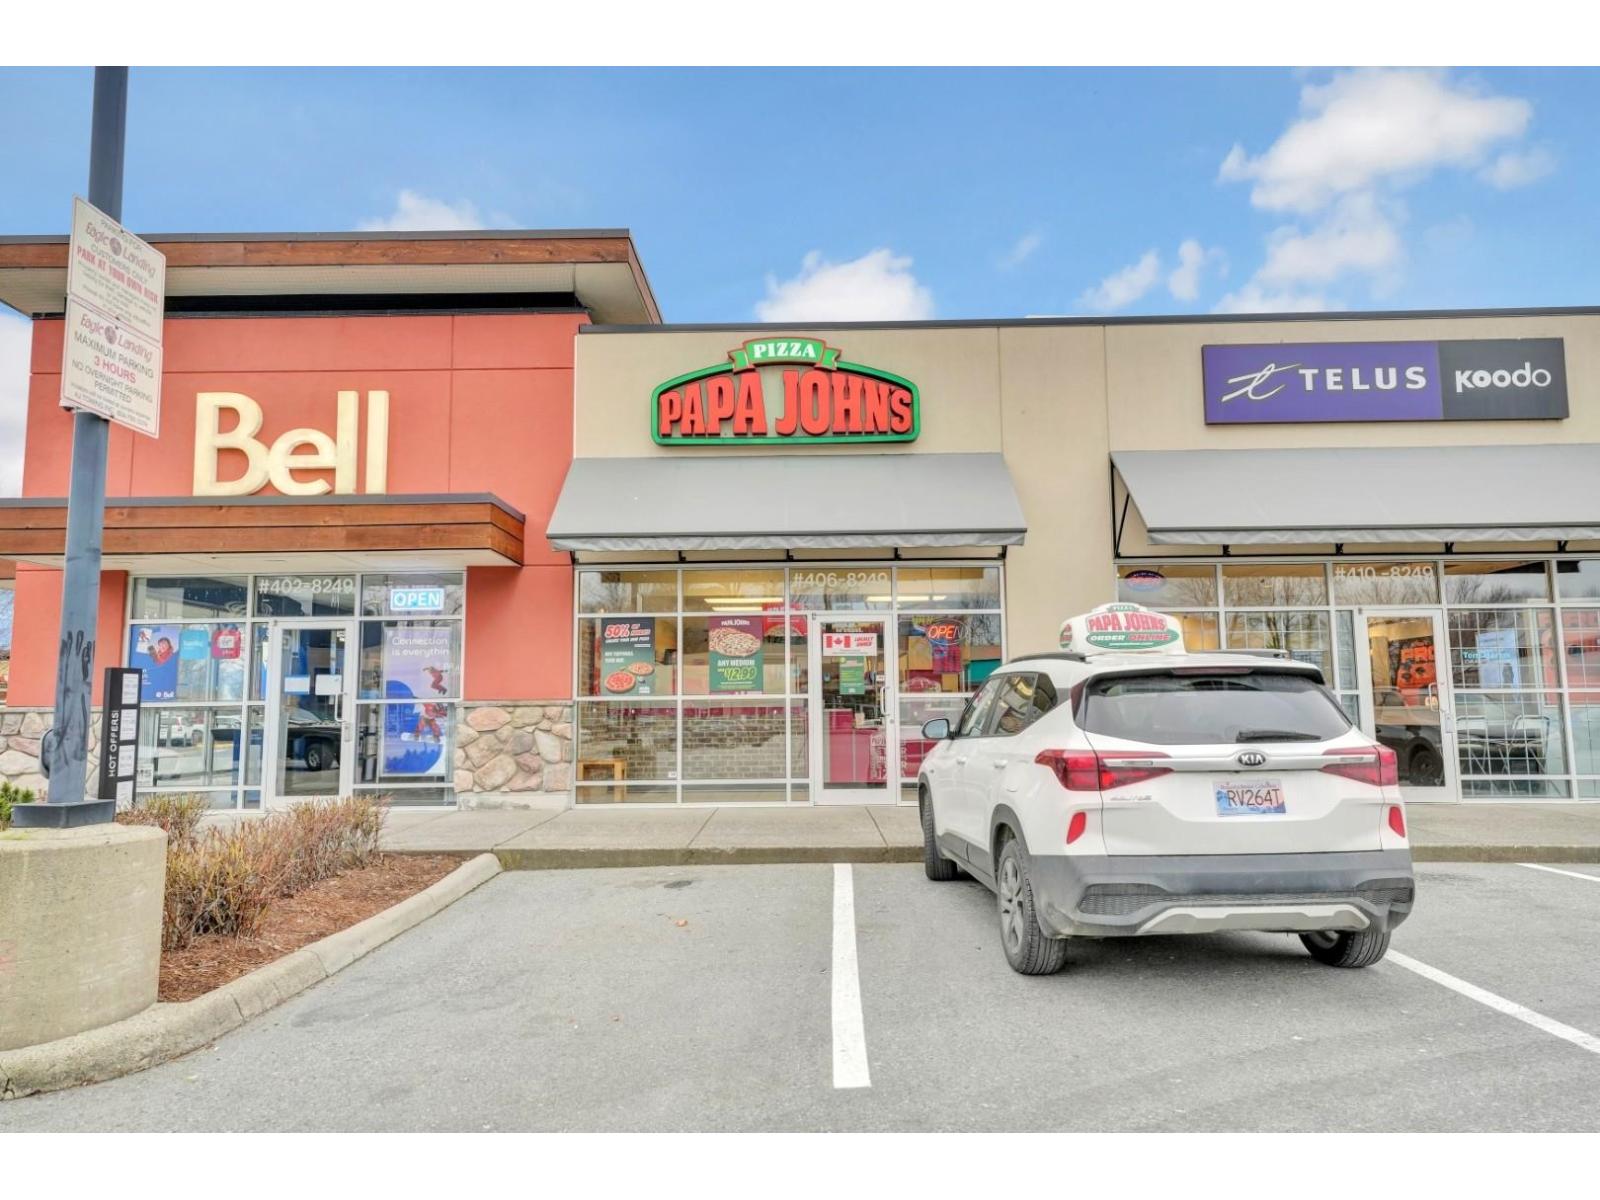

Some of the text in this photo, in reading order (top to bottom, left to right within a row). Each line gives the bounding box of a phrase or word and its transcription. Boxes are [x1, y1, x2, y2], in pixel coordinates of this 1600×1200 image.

[77, 245, 96, 265] PARK
[74, 330, 155, 379] MAXIMUM PARKING
[117, 334, 153, 363] Landing
[753, 341, 817, 359] PIZZA
[71, 359, 84, 372] NO
[94, 354, 137, 384] 3 HOURS
[1298, 365, 1428, 392] TELUS
[658, 369, 769, 437] PAPA
[192, 390, 390, 496] Bell
[258, 578, 354, 595] #402-8249
[393, 590, 440, 607] OPEN
[604, 623, 630, 639] 50%
[928, 624, 963, 639] OPEN
[1087, 612, 1123, 632] PAPA
[392, 636, 448, 646] Connection
[1089, 634, 1127, 642] ORDER
[107, 754, 118, 778] HOT
[1240, 753, 1264, 765] KIA
[1225, 788, 1281, 808] RV264T
